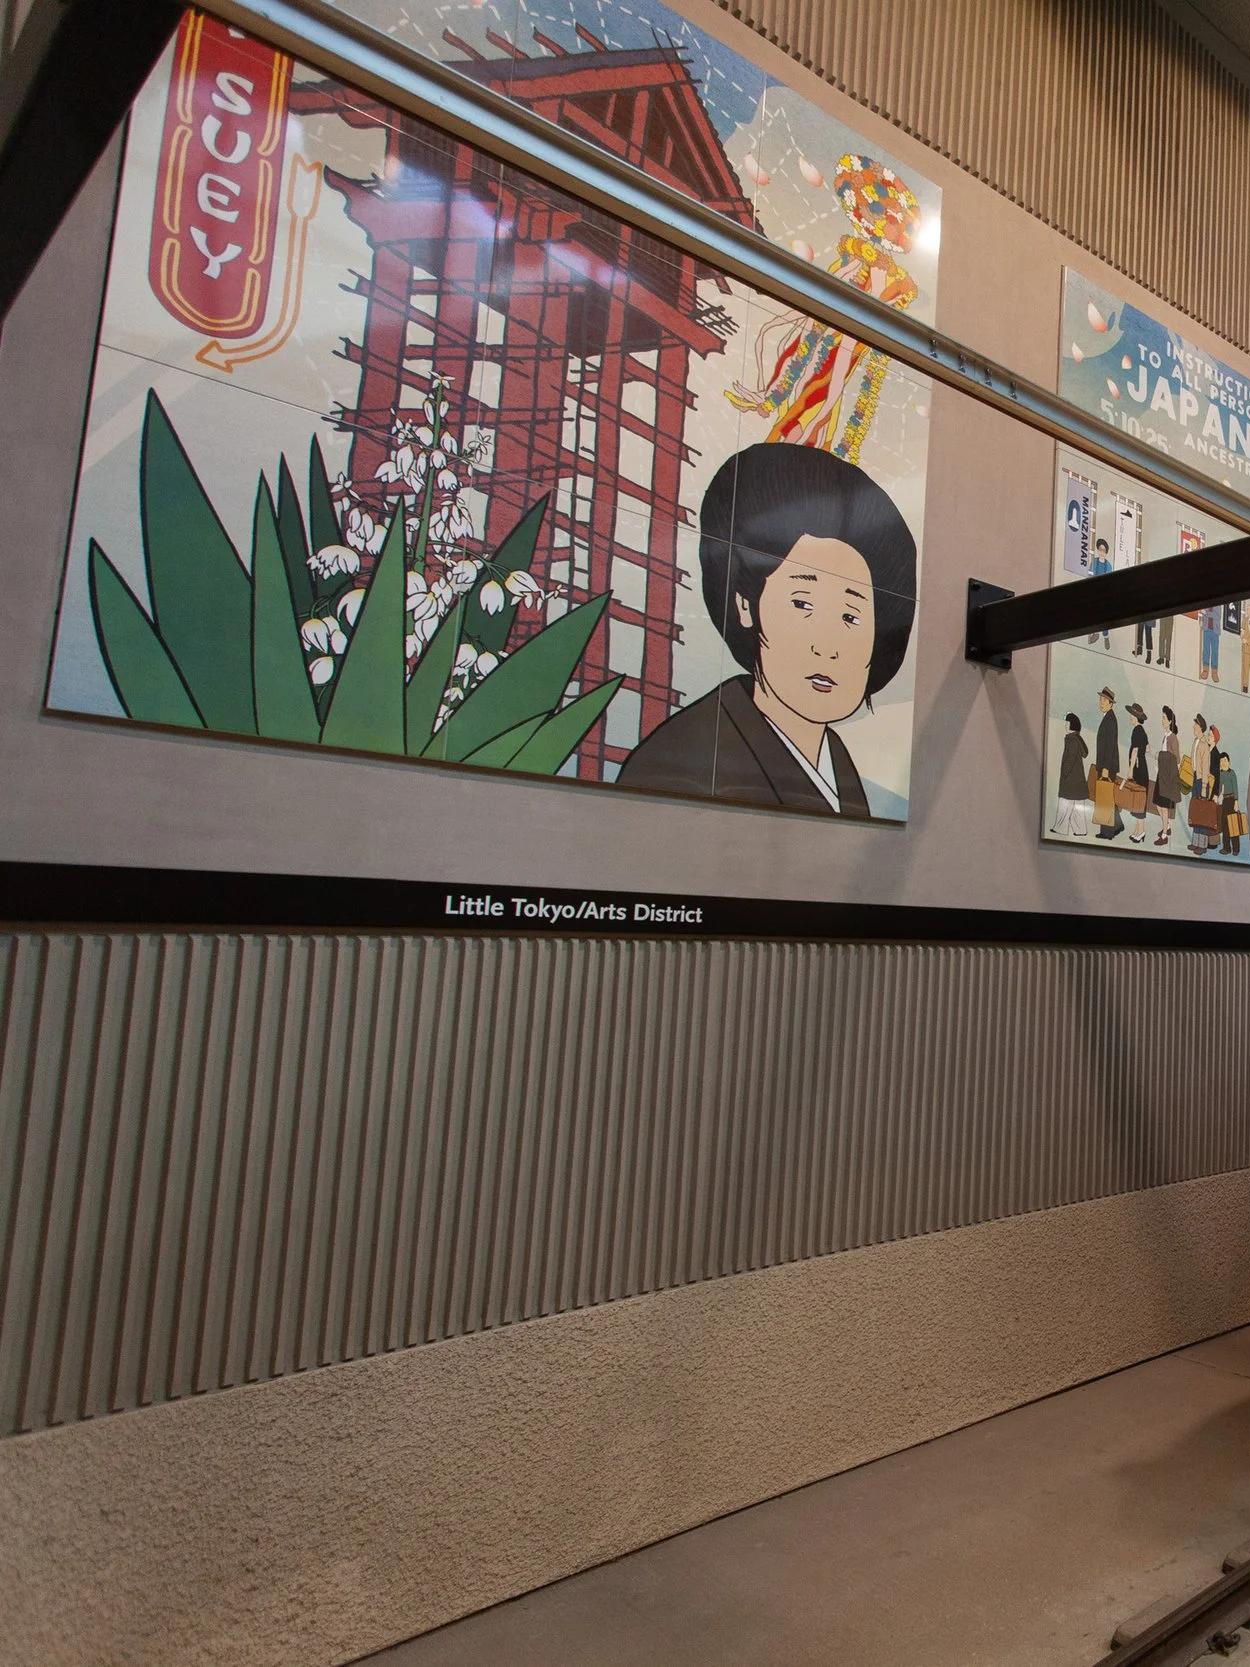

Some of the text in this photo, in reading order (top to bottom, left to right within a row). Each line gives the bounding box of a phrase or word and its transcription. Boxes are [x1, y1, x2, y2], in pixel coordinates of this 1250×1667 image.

[189, 71, 255, 280] SUEY
[1138, 343, 1162, 369] TO
[1171, 364, 1202, 393] ALL
[1080, 496, 1090, 567] MANZANAR
[445, 895, 703, 923] Little Tokyo/Arts District
